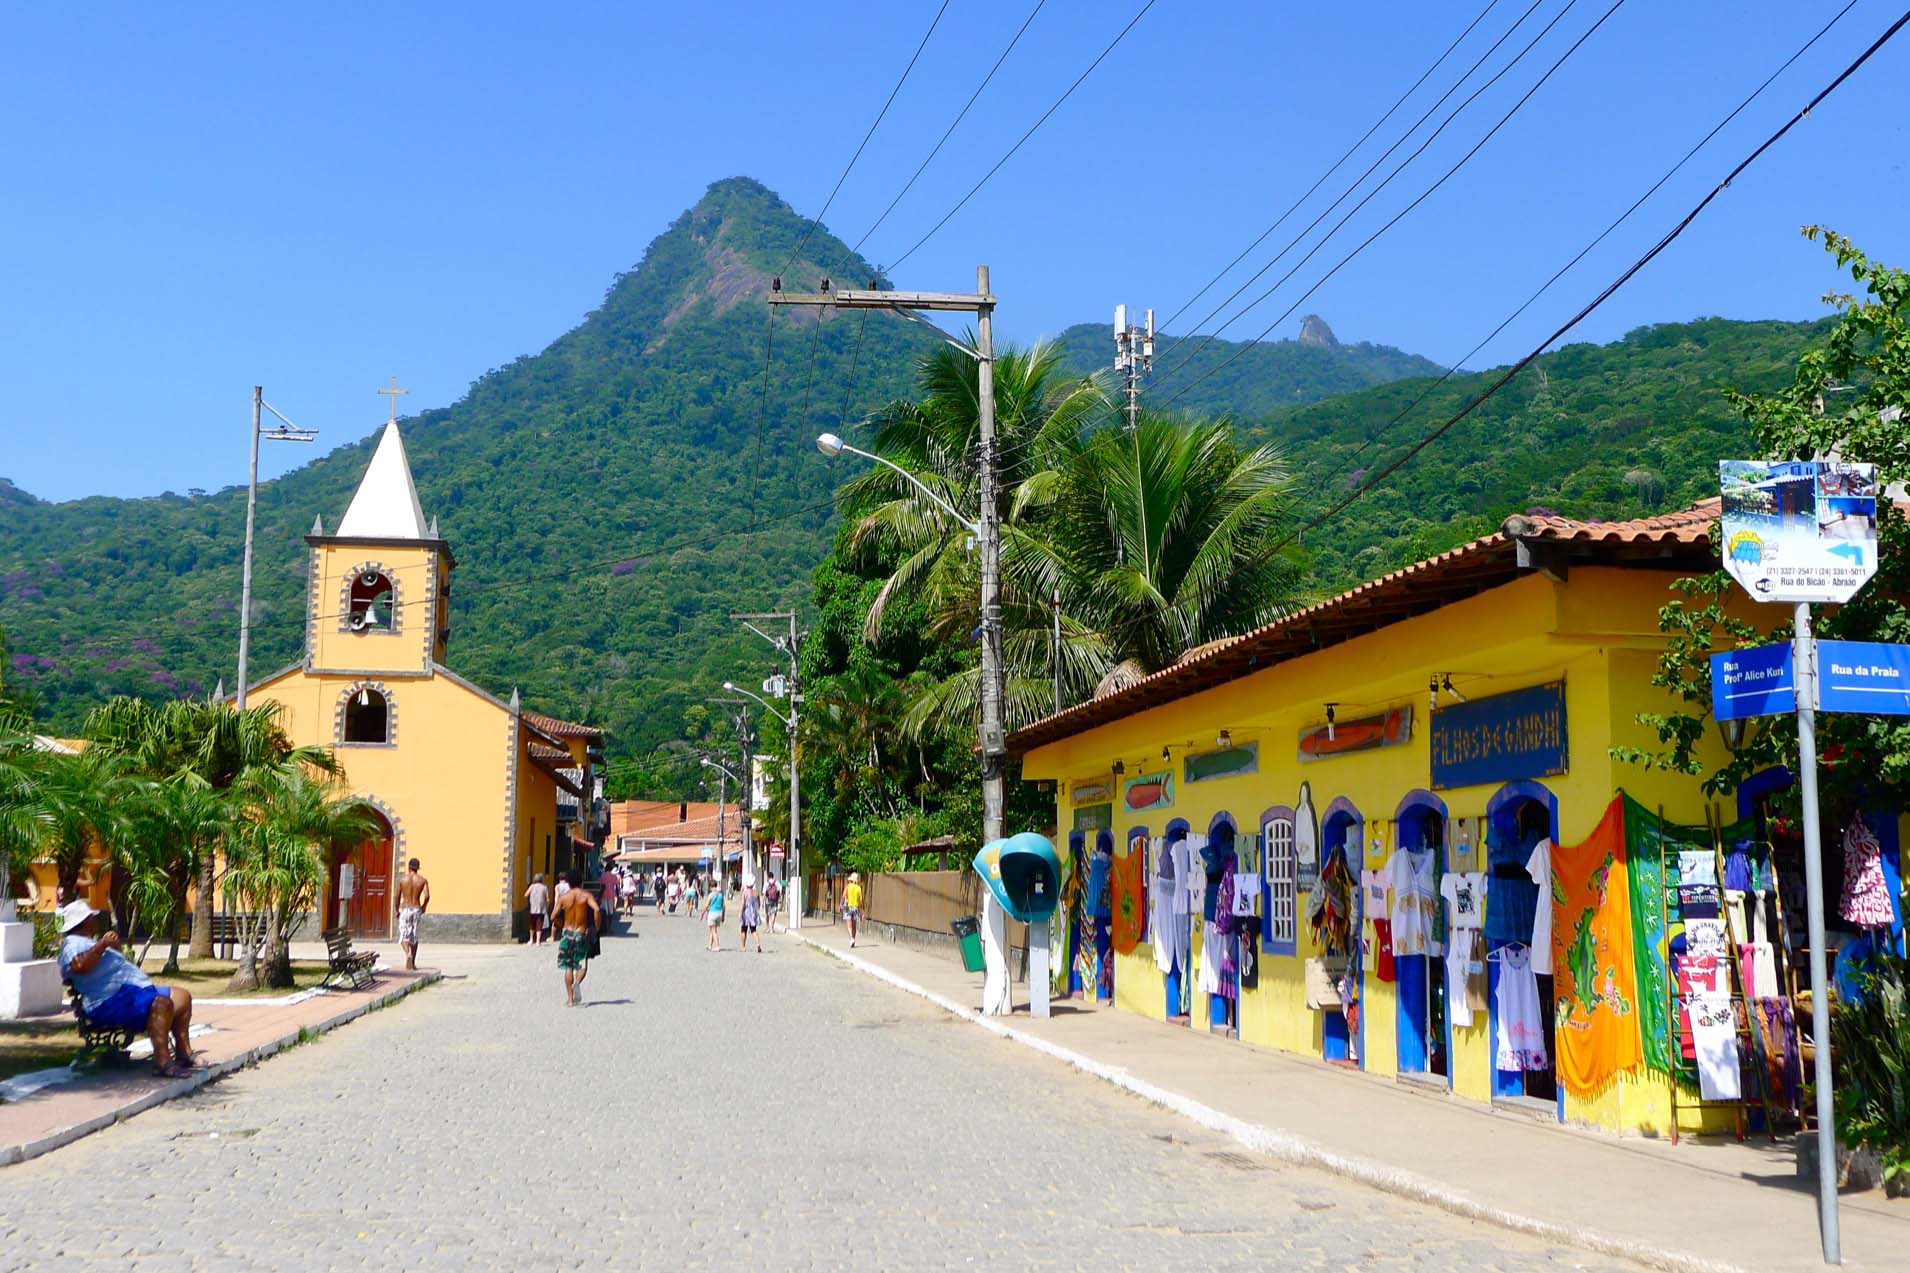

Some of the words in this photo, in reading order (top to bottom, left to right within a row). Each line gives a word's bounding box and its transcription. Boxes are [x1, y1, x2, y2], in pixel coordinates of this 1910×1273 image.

[1781, 577, 1794, 586] Rua
[1796, 577, 1805, 586] do
[1723, 661, 1739, 672] Rua
[1831, 664, 1853, 675] Rua
[1855, 665, 1869, 676] da
[1871, 665, 1900, 678] Praia
[1745, 669, 1766, 681] Alice
[1504, 705, 1560, 752] GANDHI
